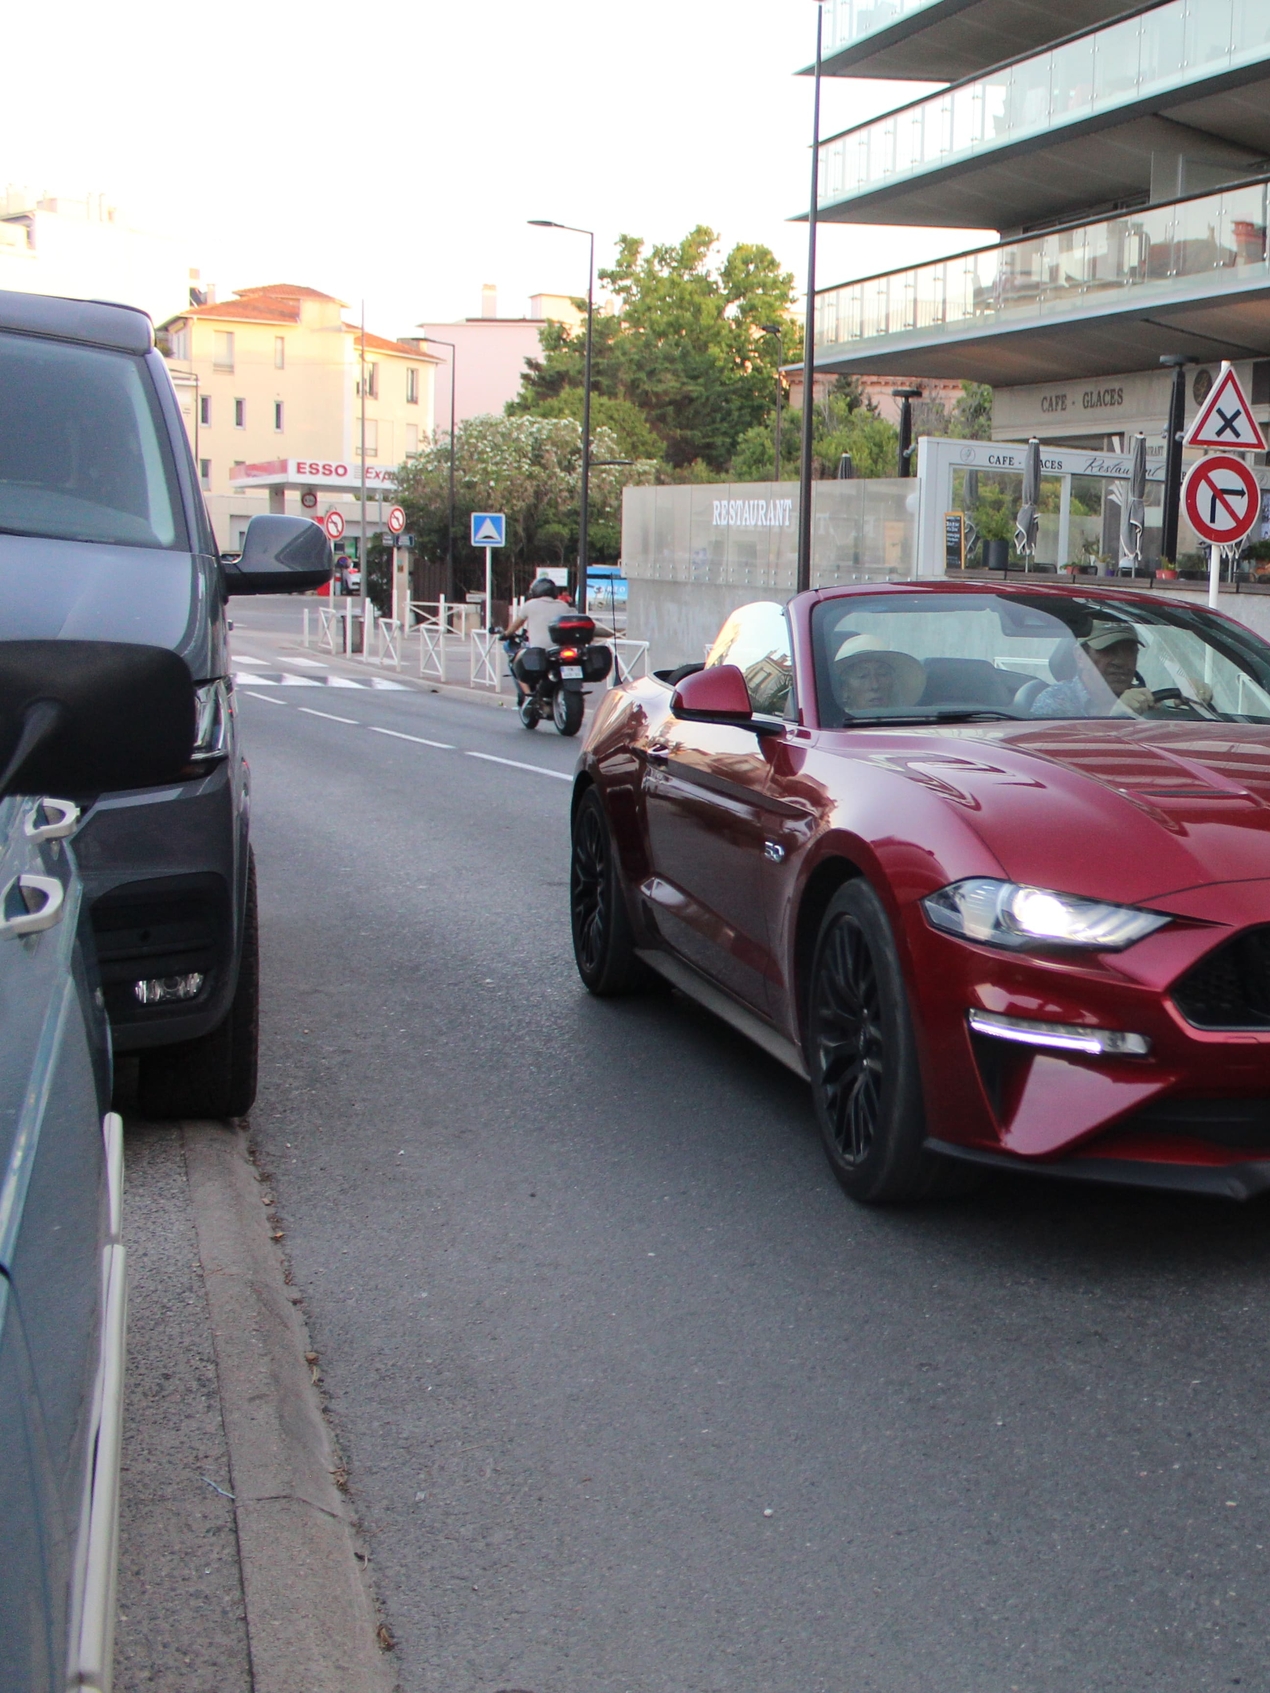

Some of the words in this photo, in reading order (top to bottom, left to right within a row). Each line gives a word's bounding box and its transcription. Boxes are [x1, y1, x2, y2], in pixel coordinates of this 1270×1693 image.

[1041, 394, 1068, 412] CAFE
[1082, 388, 1124, 409] GLACES
[296, 461, 348, 477] ESSO
[988, 454, 1015, 467] CAFE
[712, 498, 793, 527] RESTAURANT
